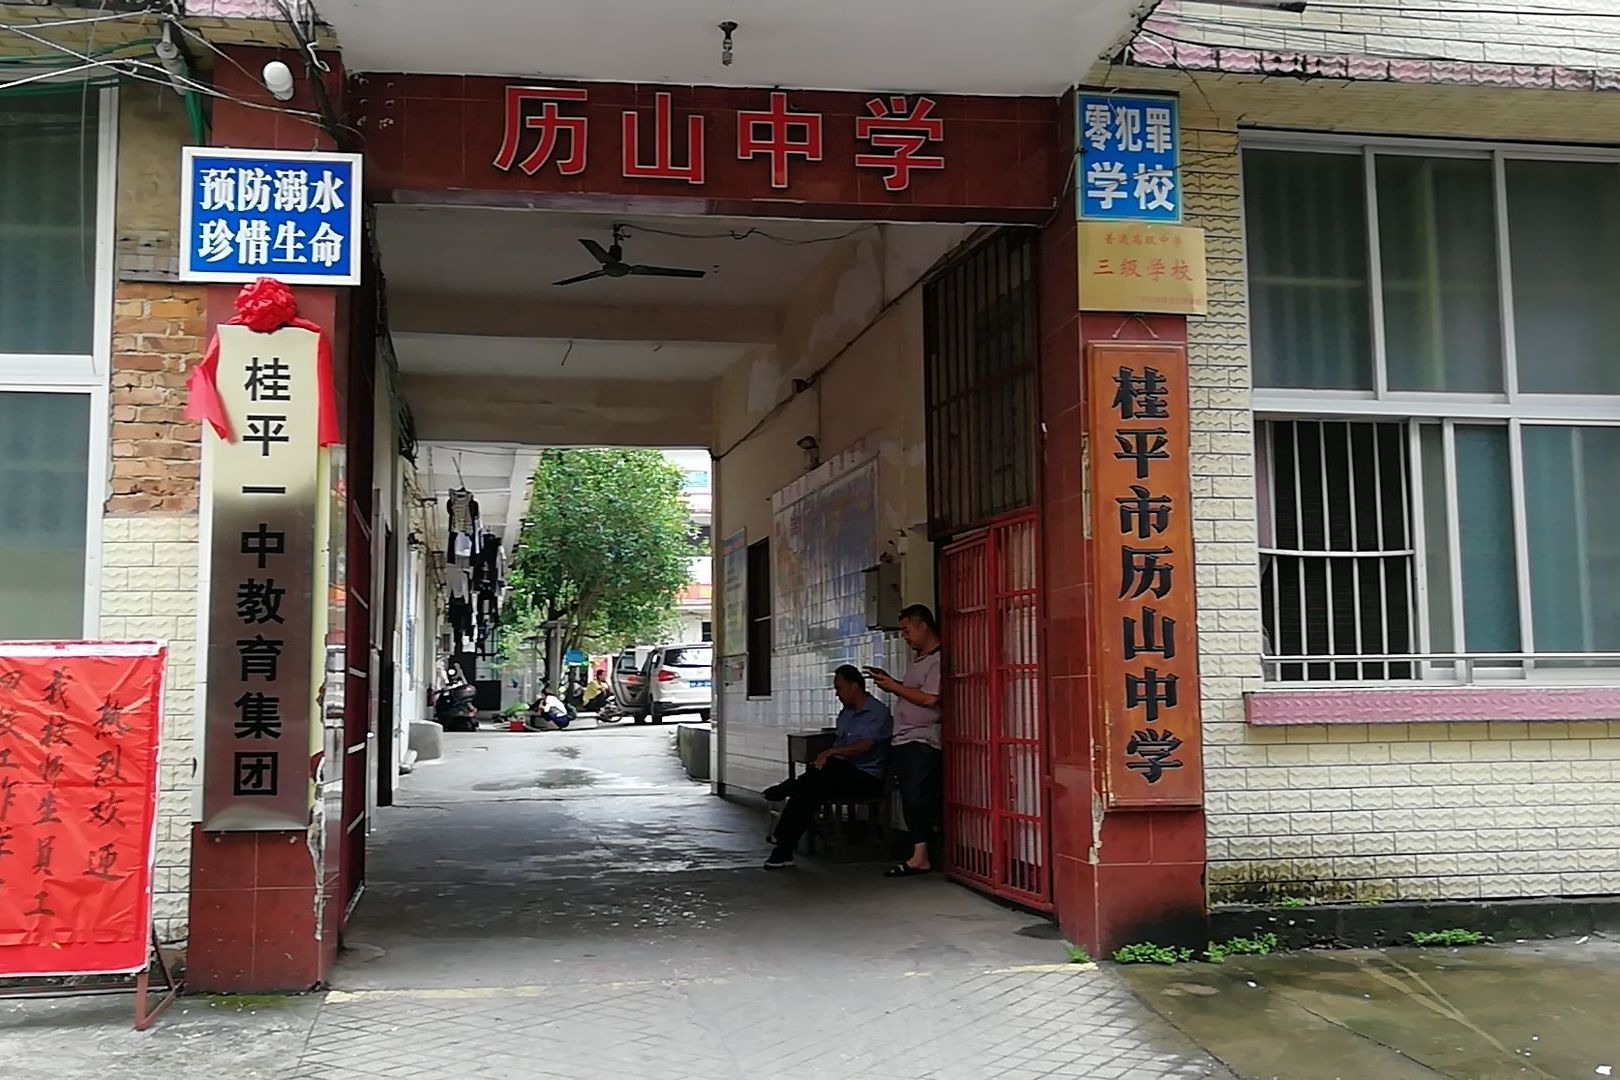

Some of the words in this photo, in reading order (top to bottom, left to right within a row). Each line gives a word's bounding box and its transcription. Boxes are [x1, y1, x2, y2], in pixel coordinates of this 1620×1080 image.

[492, 85, 945, 191] 历山中学
[1084, 104, 1173, 153] 零犯罪
[198, 167, 344, 213] 预防溺水
[1087, 162, 1175, 211] 学校
[197, 218, 344, 267] 珍惜生命
[1093, 258, 1193, 281] 三级学校
[233, 356, 291, 796] 桂平一中教育集团
[1111, 366, 1184, 784] 桂平市历山中学
